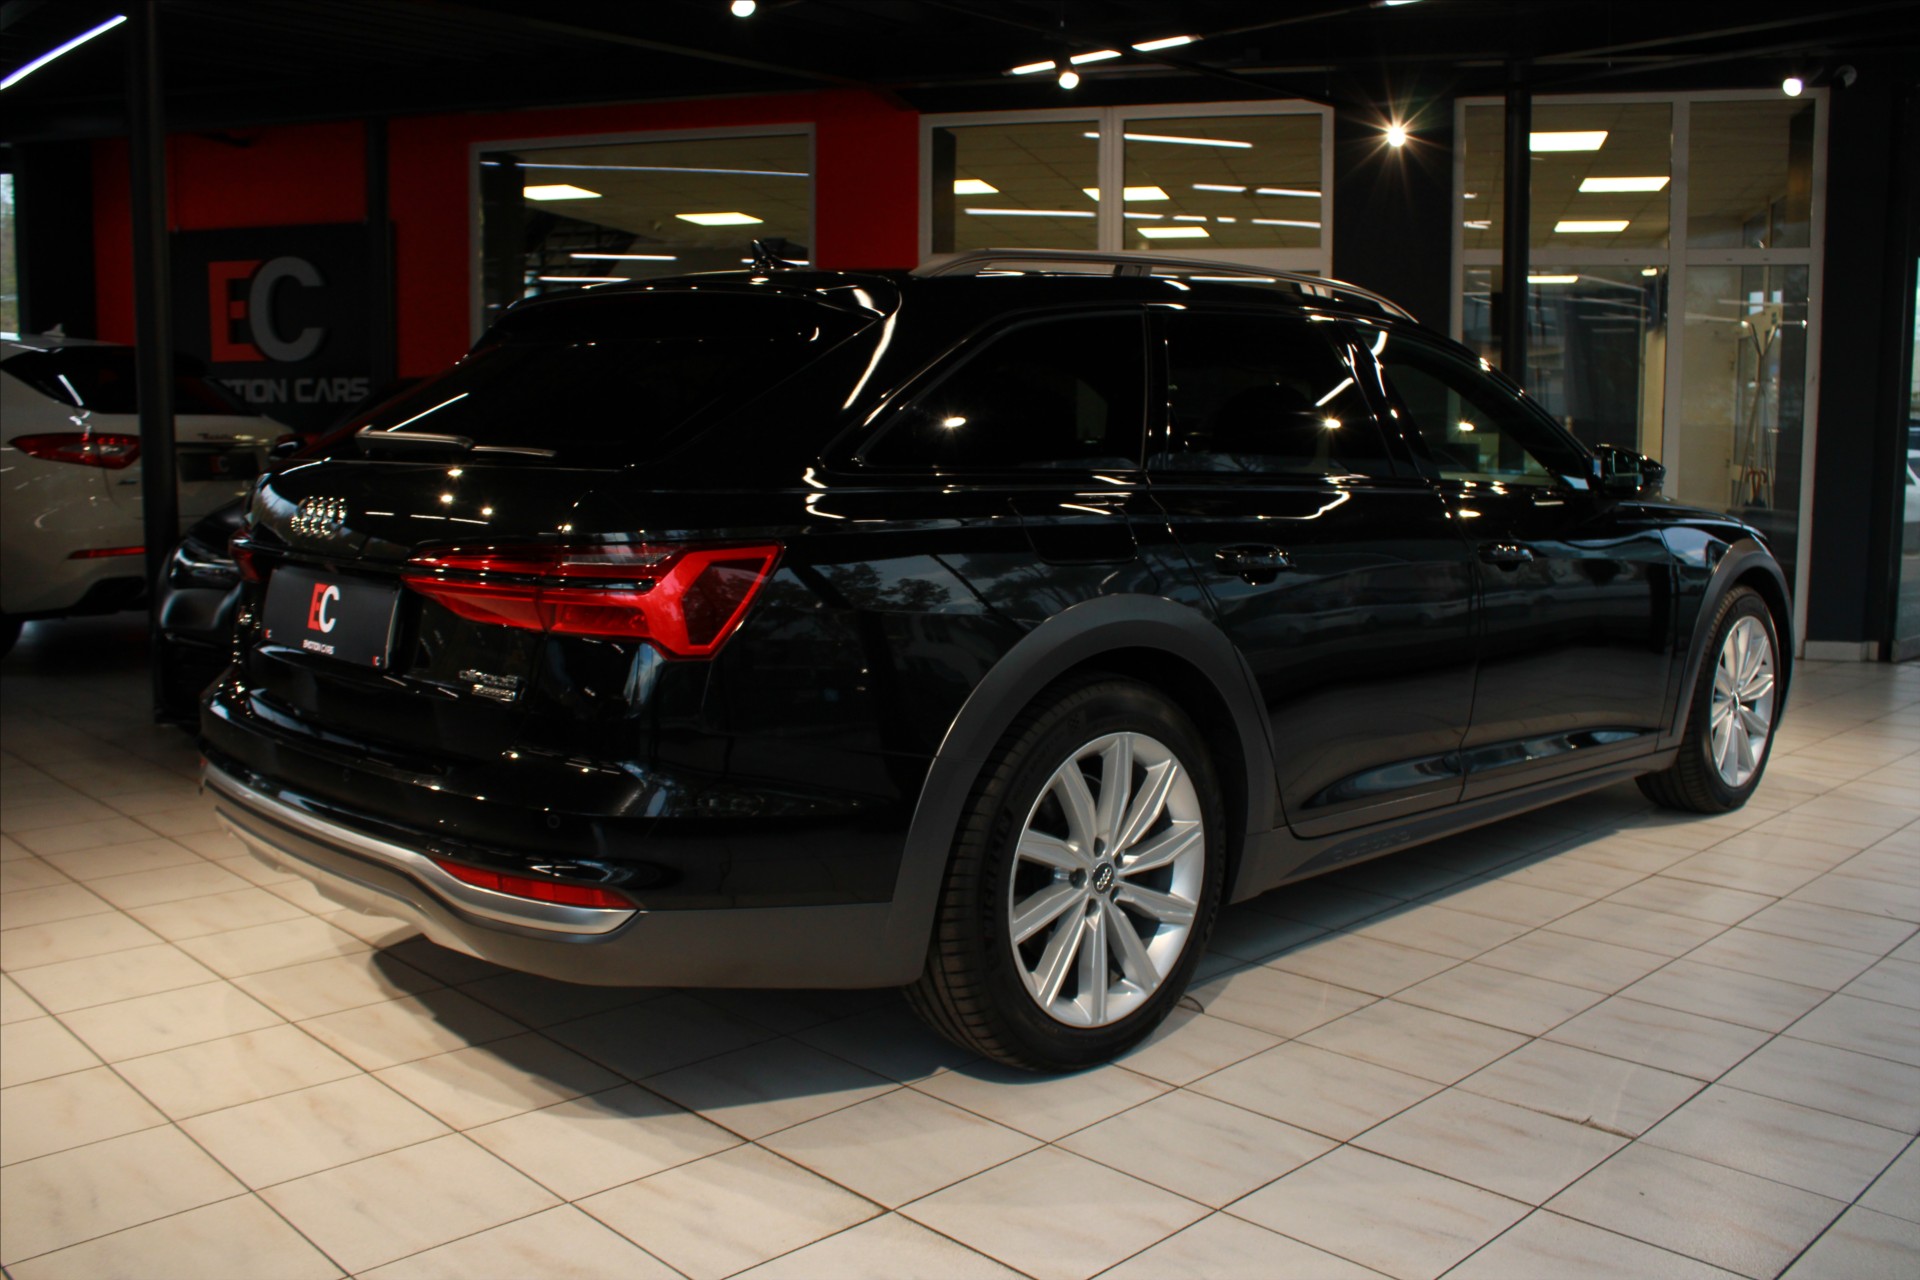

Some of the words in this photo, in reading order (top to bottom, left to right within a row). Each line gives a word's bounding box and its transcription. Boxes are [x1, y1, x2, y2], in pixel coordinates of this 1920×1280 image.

[208, 256, 328, 362] EC
[220, 378, 288, 403] TION
[294, 377, 370, 403] CARS
[307, 582, 340, 634] EC
